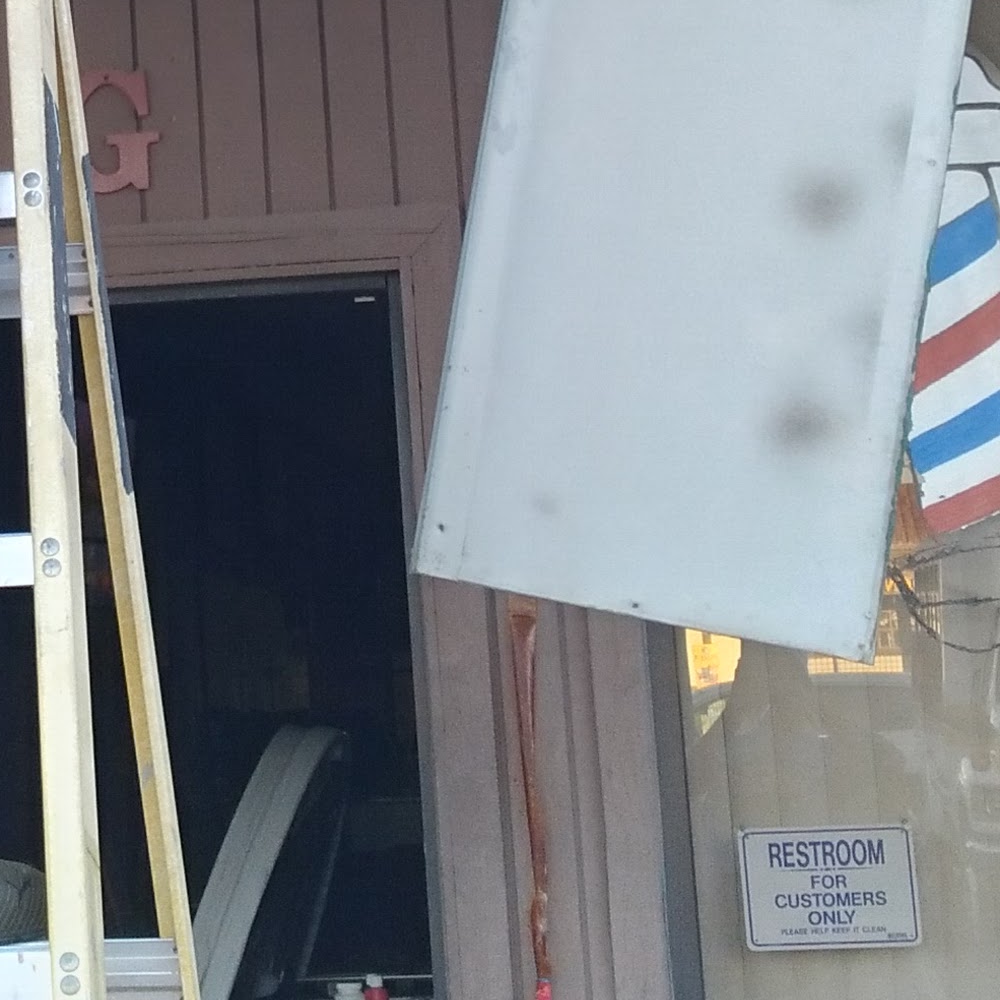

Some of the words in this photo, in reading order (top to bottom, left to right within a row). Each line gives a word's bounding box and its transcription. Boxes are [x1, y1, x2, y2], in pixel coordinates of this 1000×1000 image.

[768, 839, 885, 868] RESTROOM
[810, 874, 847, 889] FOR
[775, 891, 887, 909] CUSTOMERS
[808, 910, 856, 926] ONLY
[781, 928, 808, 936] PLEASE
[811, 927, 829, 935] HELP
[832, 926, 850, 934] KEEP
[862, 925, 887, 933] CLEAN
